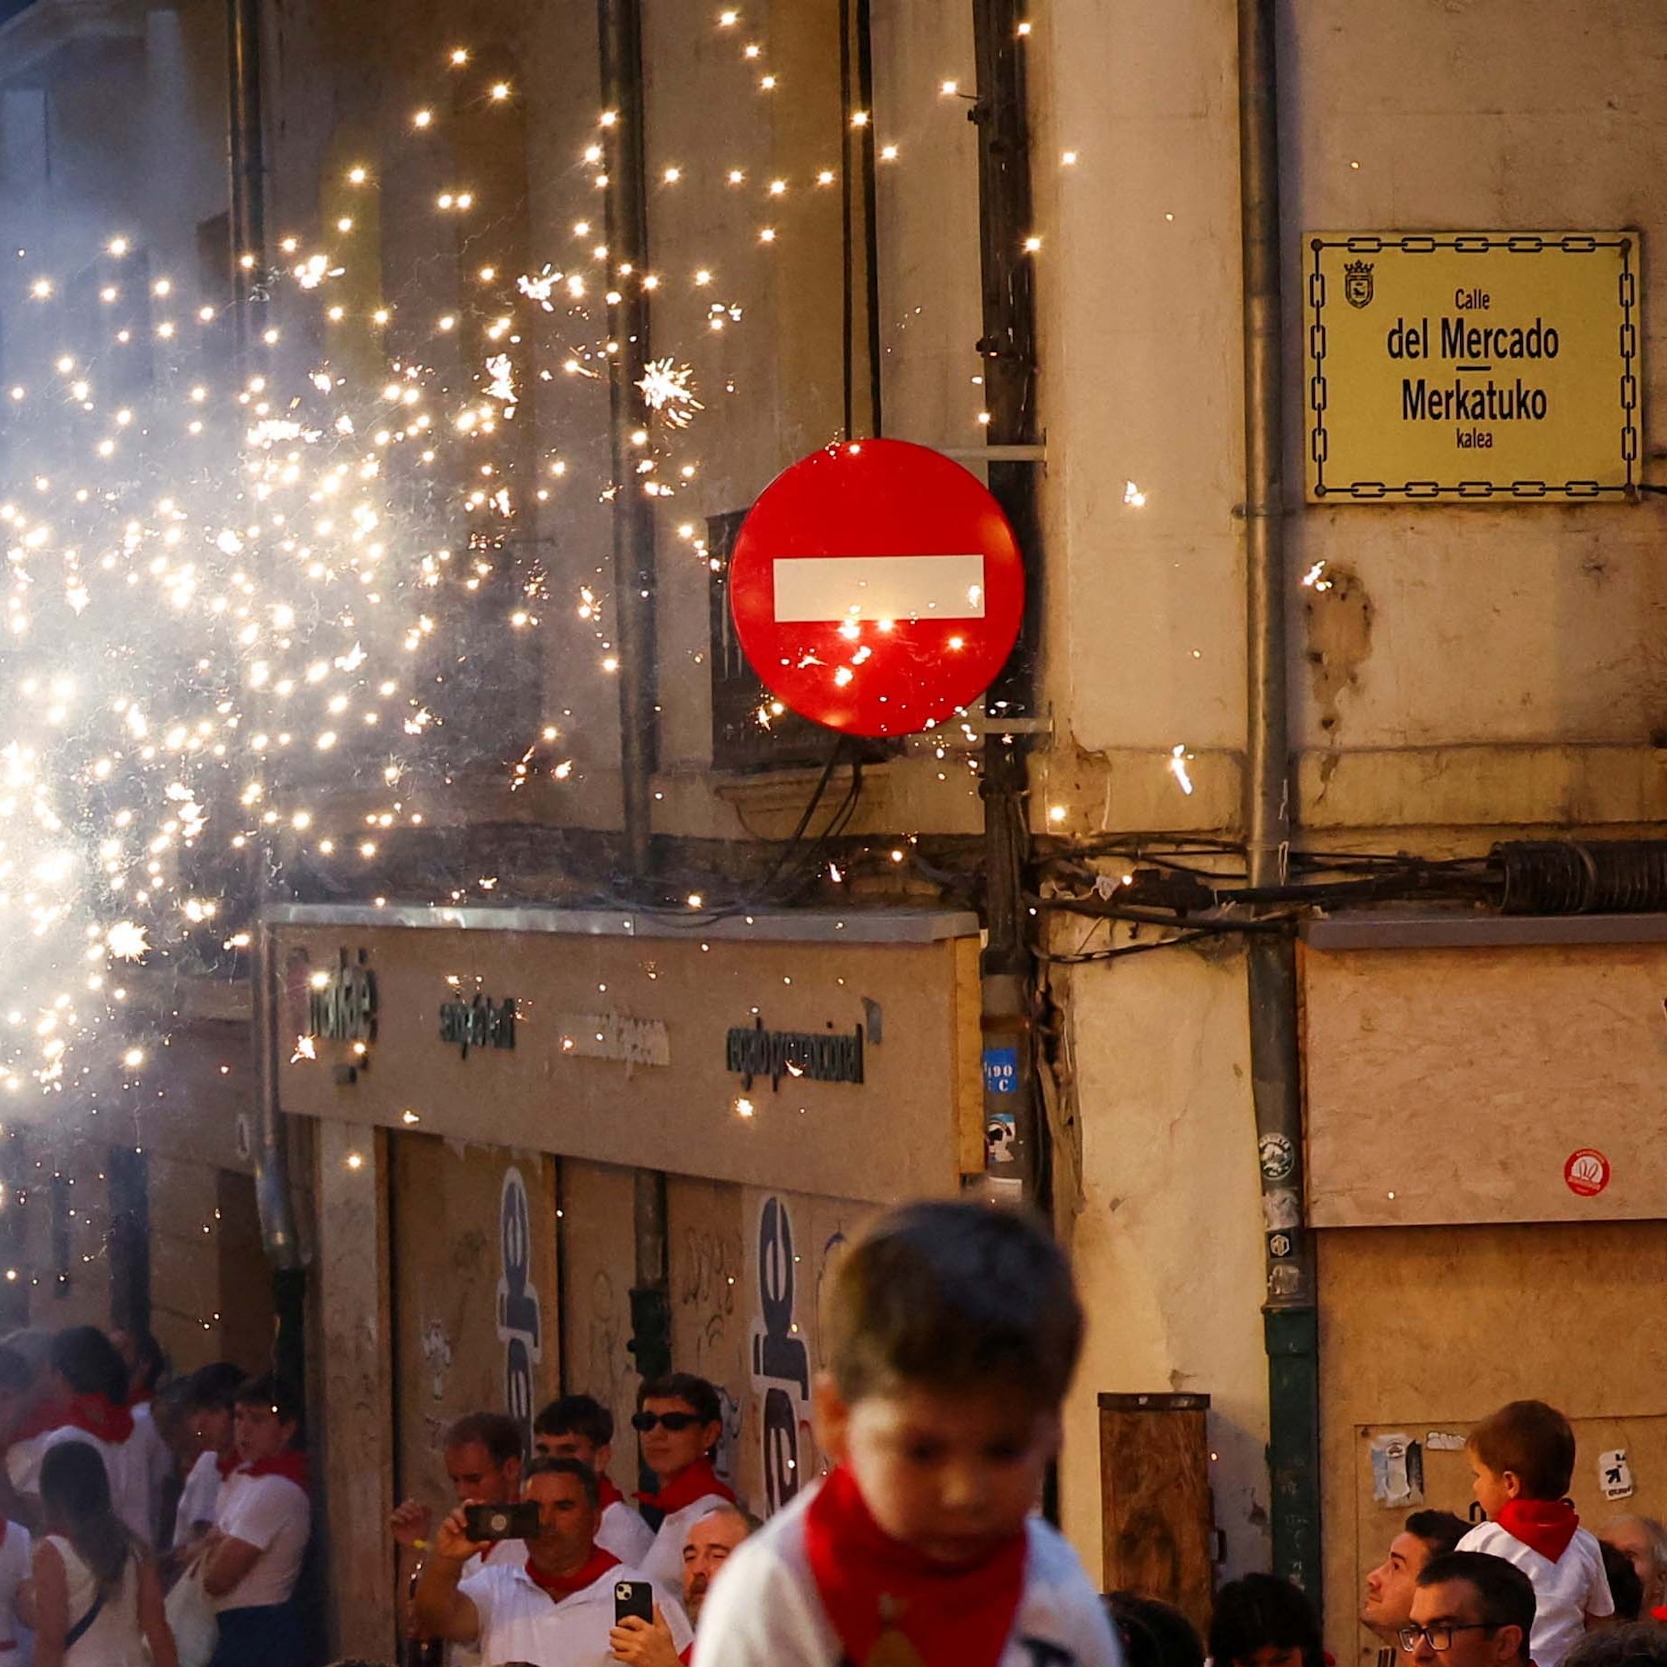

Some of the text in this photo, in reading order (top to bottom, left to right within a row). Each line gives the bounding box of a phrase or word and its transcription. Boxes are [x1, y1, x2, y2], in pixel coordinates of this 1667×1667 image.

[1455, 288, 1490, 310] Calle
[1387, 317, 1559, 359] del Mercado
[1402, 378, 1547, 420] Merkatuko
[1456, 427, 1493, 448] kalea
